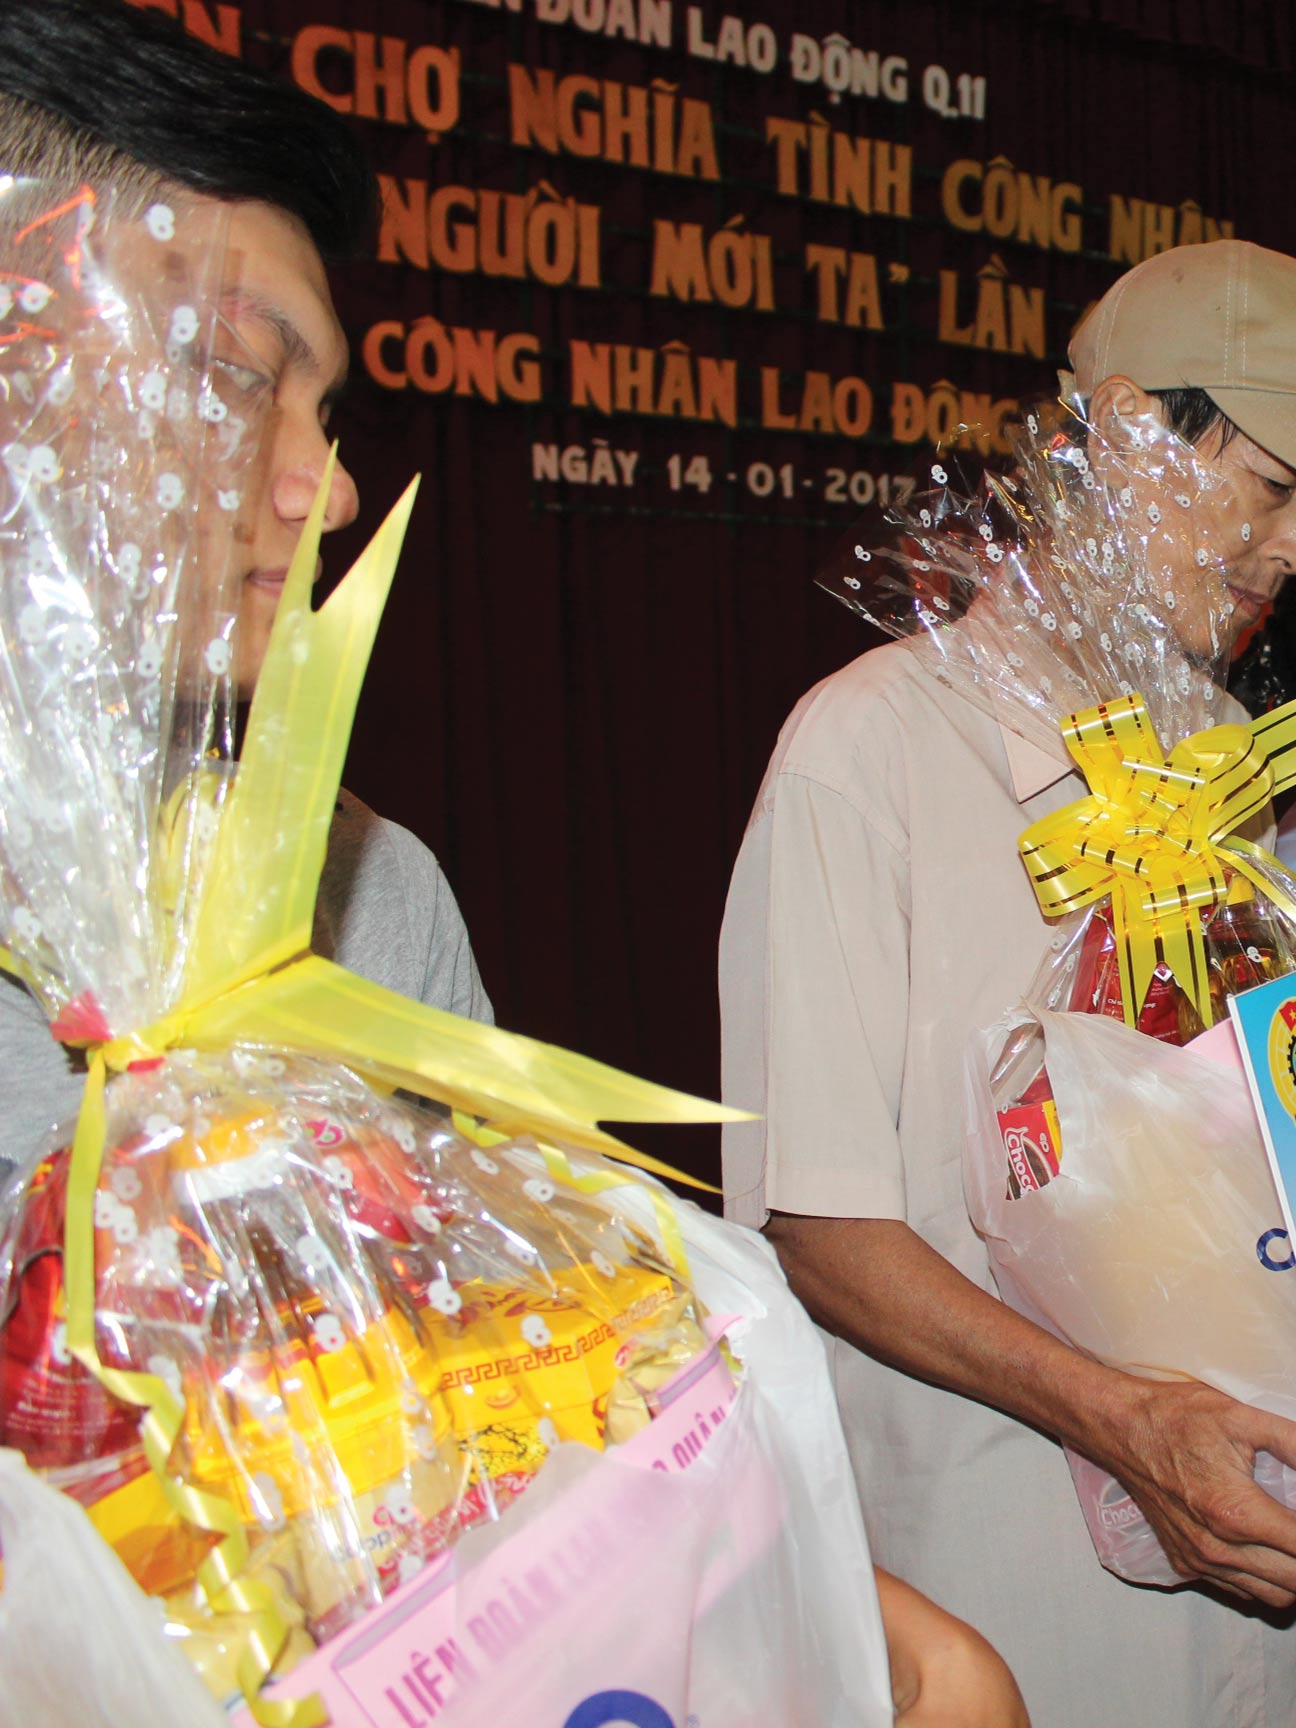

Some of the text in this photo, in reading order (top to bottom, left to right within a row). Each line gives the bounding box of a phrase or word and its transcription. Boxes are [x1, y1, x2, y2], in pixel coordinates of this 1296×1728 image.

[687, 6, 777, 73] LAO
[790, 33, 909, 104] ĐỘNG
[292, 24, 461, 145] CHỢ
[508, 62, 721, 181] NGHĨA
[766, 110, 912, 218] TÌNH
[942, 155, 1081, 252] CÔNG
[376, 178, 600, 288] NGƯỜI
[649, 213, 774, 311] MỚI
[938, 253, 1045, 360] LẦN
[363, 315, 541, 404] CÔNG
[570, 340, 737, 429] NHÂN
[761, 366, 873, 437] LAO
